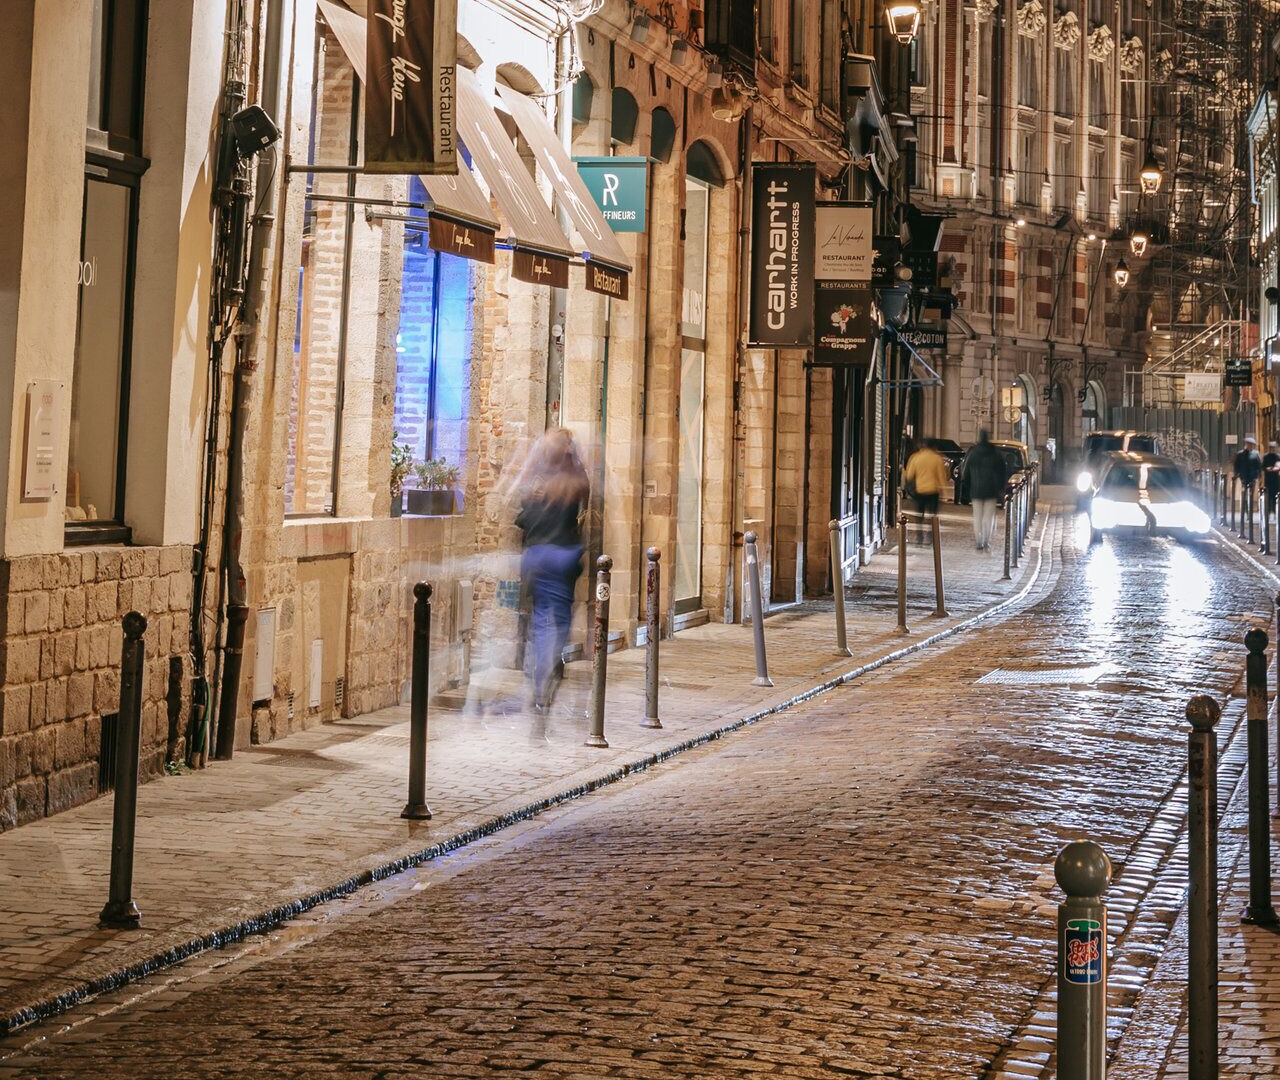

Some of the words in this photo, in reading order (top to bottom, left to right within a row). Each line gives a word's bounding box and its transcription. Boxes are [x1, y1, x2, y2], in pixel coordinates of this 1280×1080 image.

[439, 66, 454, 156] Restaurant
[602, 173, 620, 206] R
[603, 210, 636, 220] FFINEURS
[792, 202, 800, 261] PROGRESS
[593, 267, 622, 295] Restaurant
[791, 263, 798, 274] IN
[790, 276, 798, 309] WORK
[922, 333, 944, 344] COTON
